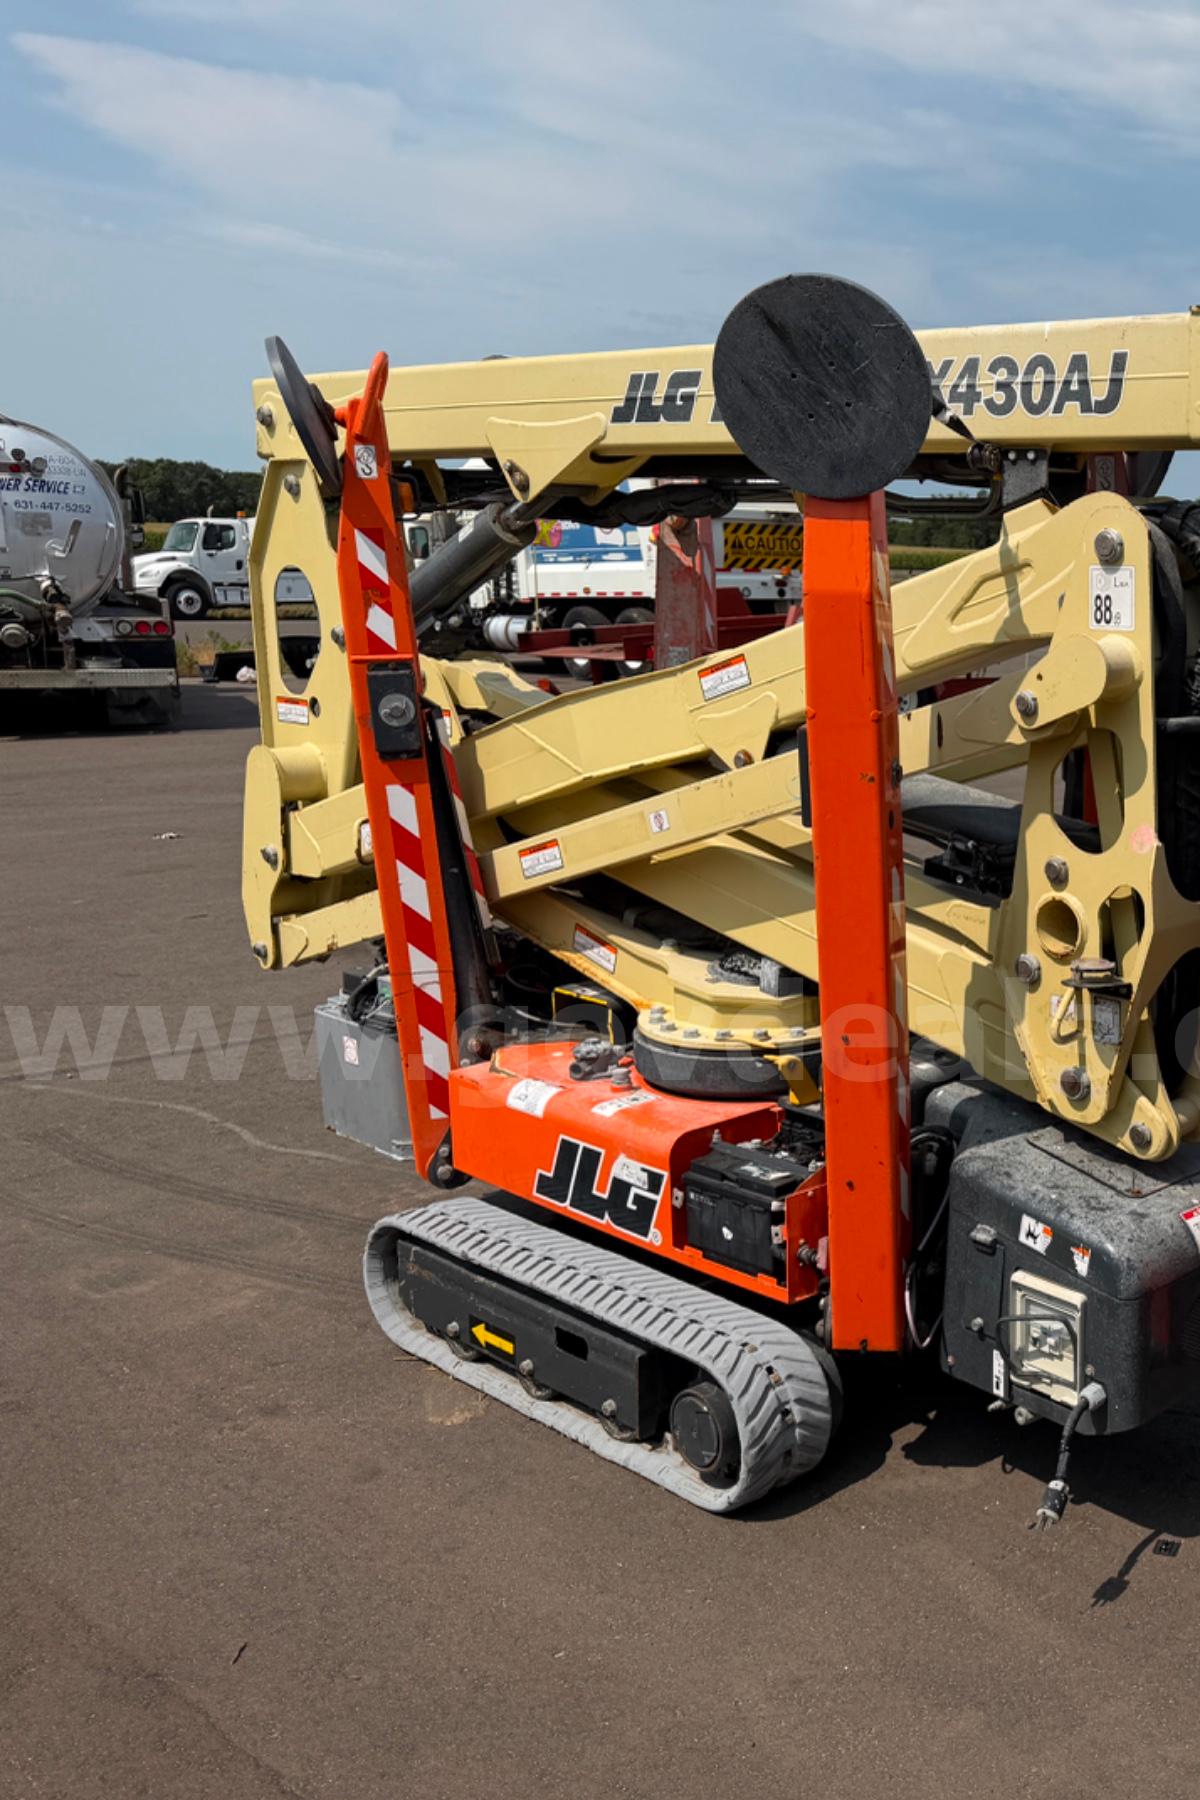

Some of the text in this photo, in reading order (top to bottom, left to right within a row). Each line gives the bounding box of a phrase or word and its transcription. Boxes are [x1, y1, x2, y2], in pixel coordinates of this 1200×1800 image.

[608, 368, 704, 425] JLG
[24, 478, 71, 495] SERVICE
[745, 535, 803, 551] CAUTIO
[1094, 593, 1112, 625] 88
[532, 1133, 669, 1243] JLG
